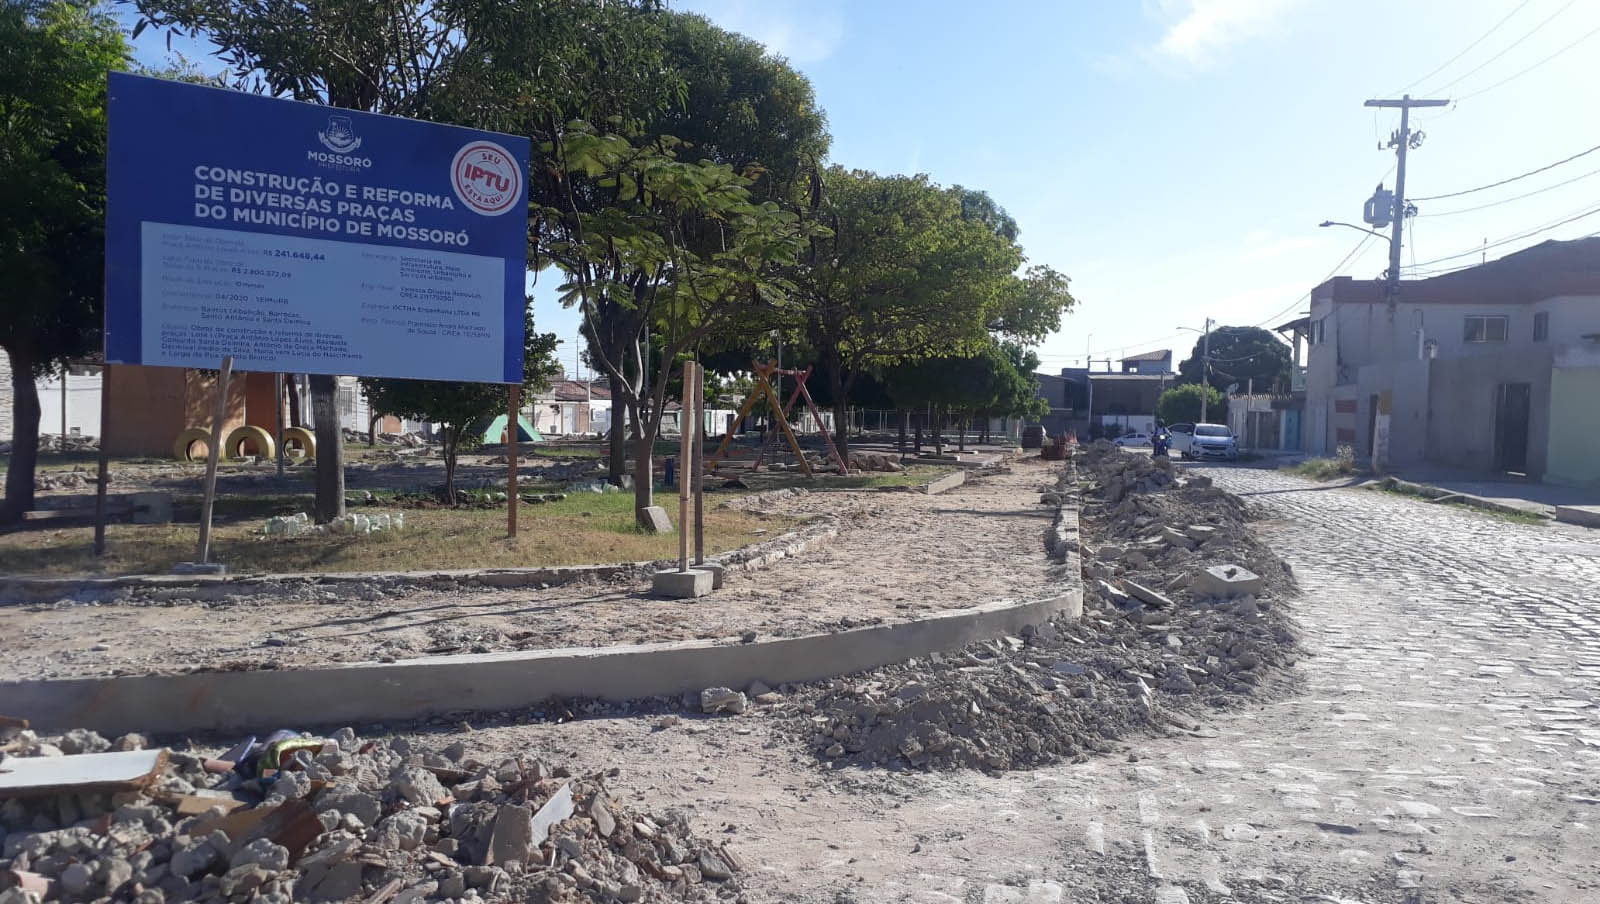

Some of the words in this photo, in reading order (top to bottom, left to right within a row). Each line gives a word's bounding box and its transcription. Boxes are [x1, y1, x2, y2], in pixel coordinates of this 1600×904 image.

[307, 150, 372, 168] MOSSORÓ
[481, 152, 502, 165] SEU
[194, 165, 340, 195] CONSTRUÇÃO
[345, 184, 357, 199] E
[362, 186, 455, 210] REFORMA
[463, 162, 510, 193] IPTU
[194, 184, 224, 202] DE
[230, 187, 332, 214] DIVERSAS
[337, 201, 416, 223] PRAÇAS
[483, 193, 505, 205] AQUI
[194, 202, 228, 220] DO
[233, 206, 341, 233] MUNICÍPIO
[346, 220, 372, 236] DE
[377, 223, 469, 247] MOSSORÓ
